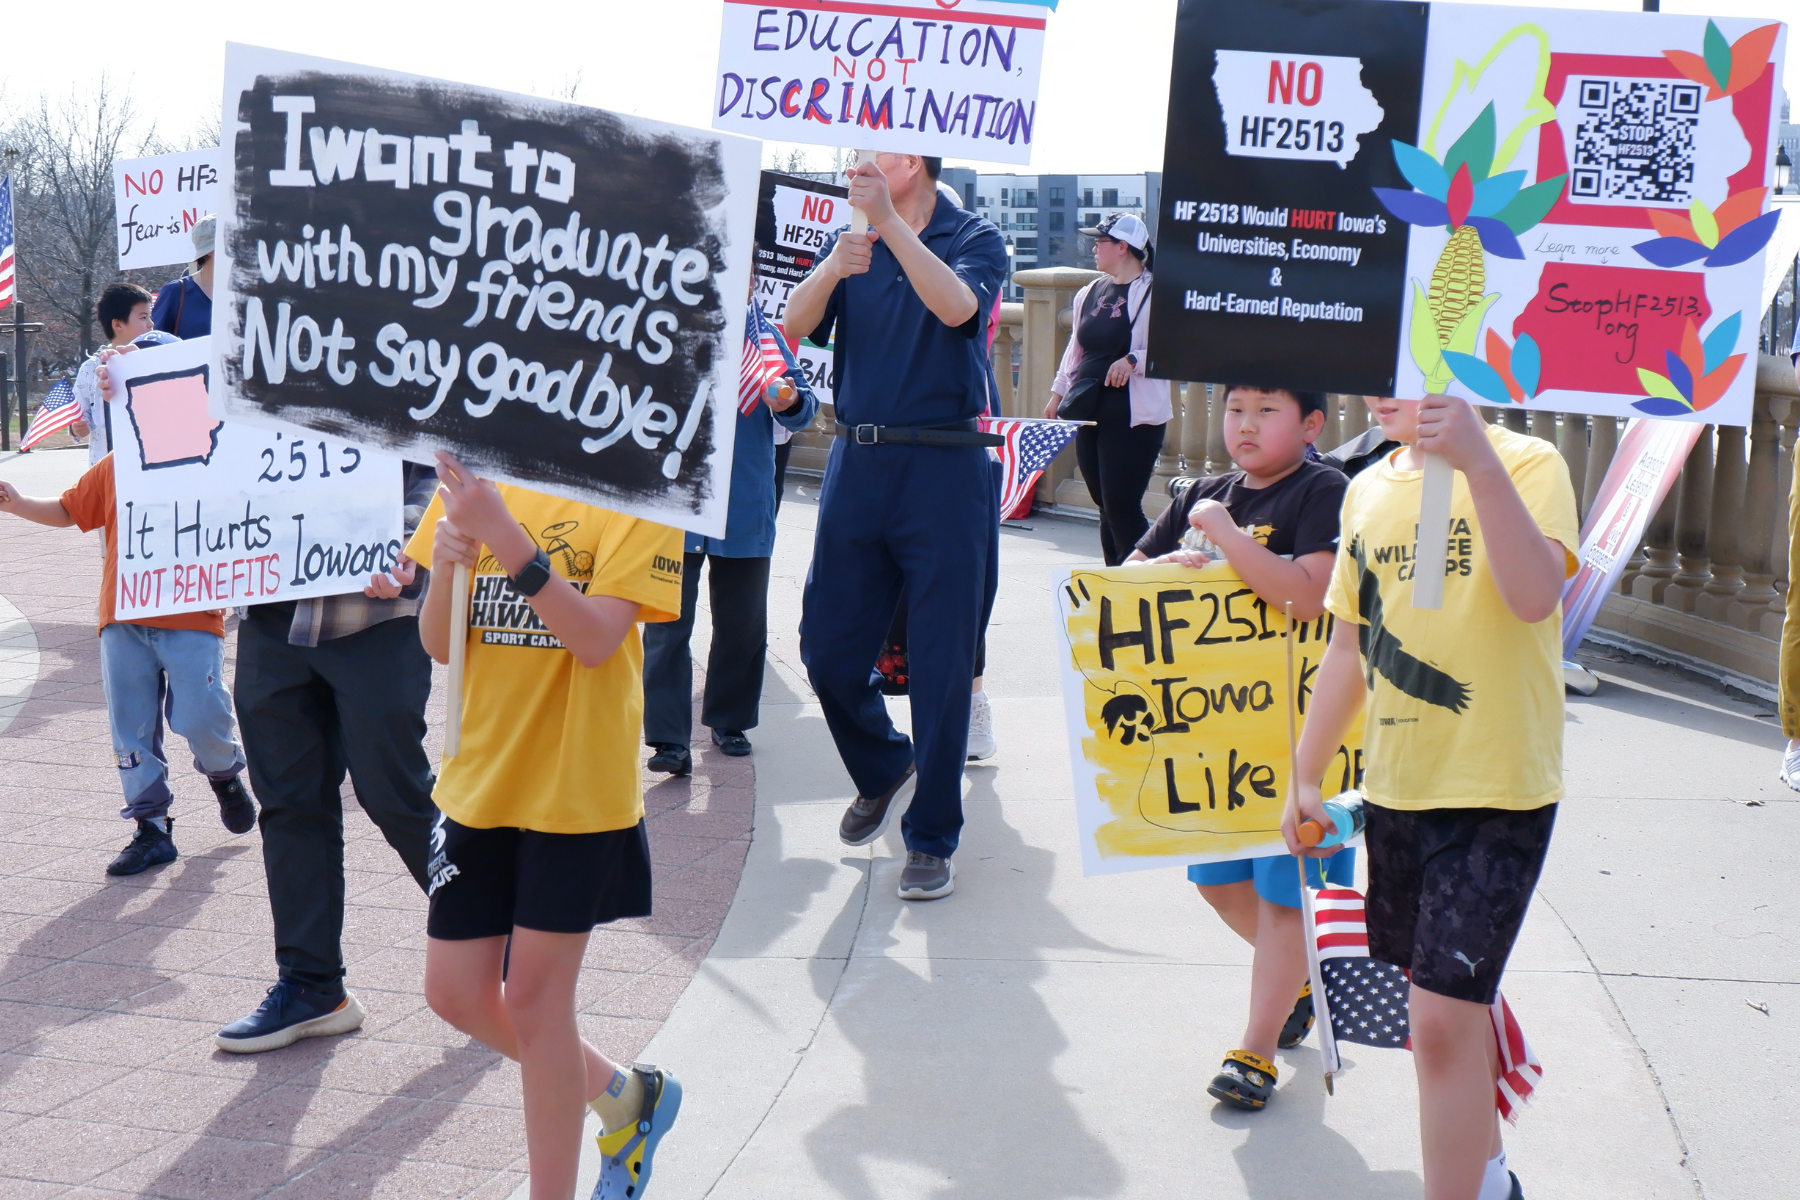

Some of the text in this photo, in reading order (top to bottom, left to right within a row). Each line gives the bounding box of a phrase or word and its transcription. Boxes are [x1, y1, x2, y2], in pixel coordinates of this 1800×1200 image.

[754, 9, 1023, 77] EDUCATION,
[833, 55, 917, 85] NOT
[1267, 59, 1324, 106] NO
[719, 72, 1036, 145] DISCRIMINATION
[269, 95, 317, 188] I
[504, 141, 576, 204] to
[1240, 114, 1346, 153] HF2513
[1617, 143, 1655, 157] HF2513
[1619, 125, 1655, 141] STOP
[124, 164, 218, 198] NO HF2
[801, 194, 834, 224] NO
[1174, 200, 1387, 235] HF 2513 Would HURT Iowa's
[121, 204, 164, 256] fear
[429, 190, 710, 306] graduate
[1534, 232, 1621, 255] Learn more
[776, 253, 795, 265] Would
[795, 257, 814, 268] HURT
[1197, 231, 1362, 267] Universities, Economy
[776, 267, 789, 276] and
[1269, 266, 1283, 287] &
[258, 223, 679, 365] with my friends
[1184, 289, 1364, 323] Hard-Earned Reputation
[1605, 322, 1639, 364] org
[125, 499, 402, 587] It Hurts Iowans
[121, 553, 281, 610] NOT BENEFITS
[651, 554, 683, 576] IOW
[485, 631, 565, 648] SPORT CAM
[1151, 676, 1275, 735] Iowa
[1164, 748, 1277, 814] Like
